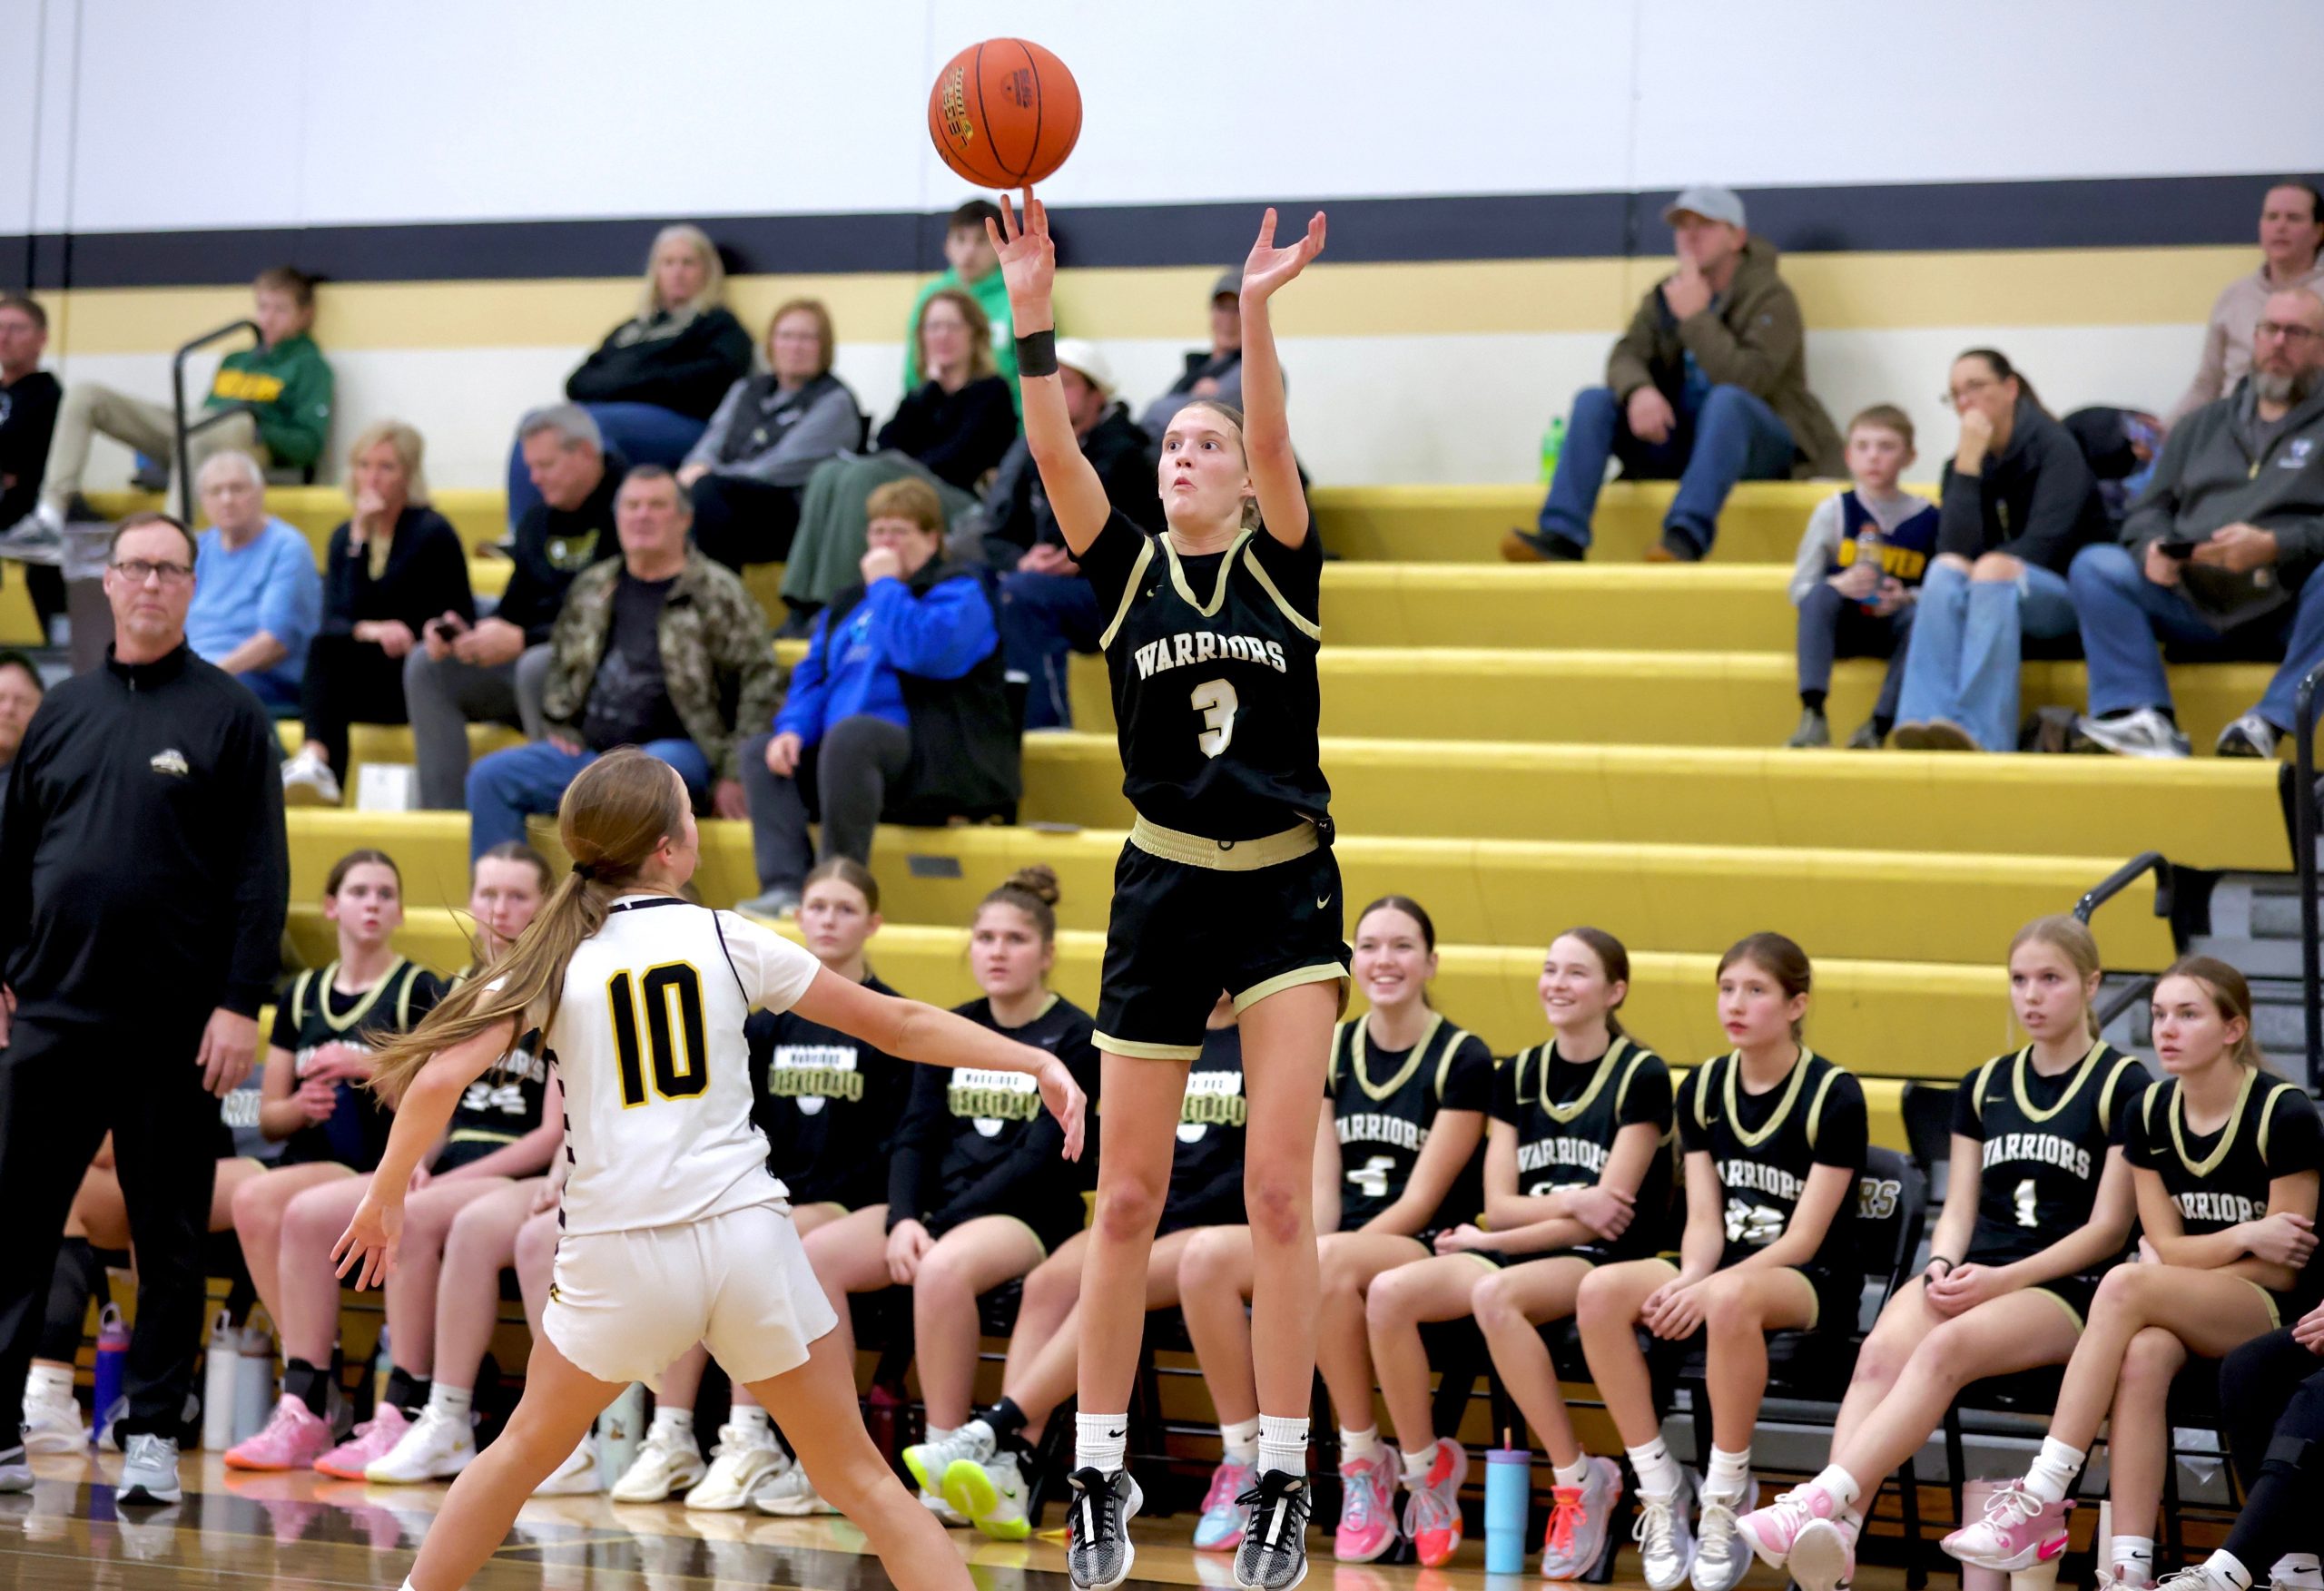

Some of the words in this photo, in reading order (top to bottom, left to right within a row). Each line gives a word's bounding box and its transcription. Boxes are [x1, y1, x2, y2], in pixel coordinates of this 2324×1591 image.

[1135, 632, 1286, 681] WARRIORS
[1191, 678, 1238, 759] 3
[606, 959, 710, 1109] 10
[1181, 1091, 1246, 1127] ETBALL
[2014, 1179, 2038, 1227] 1
